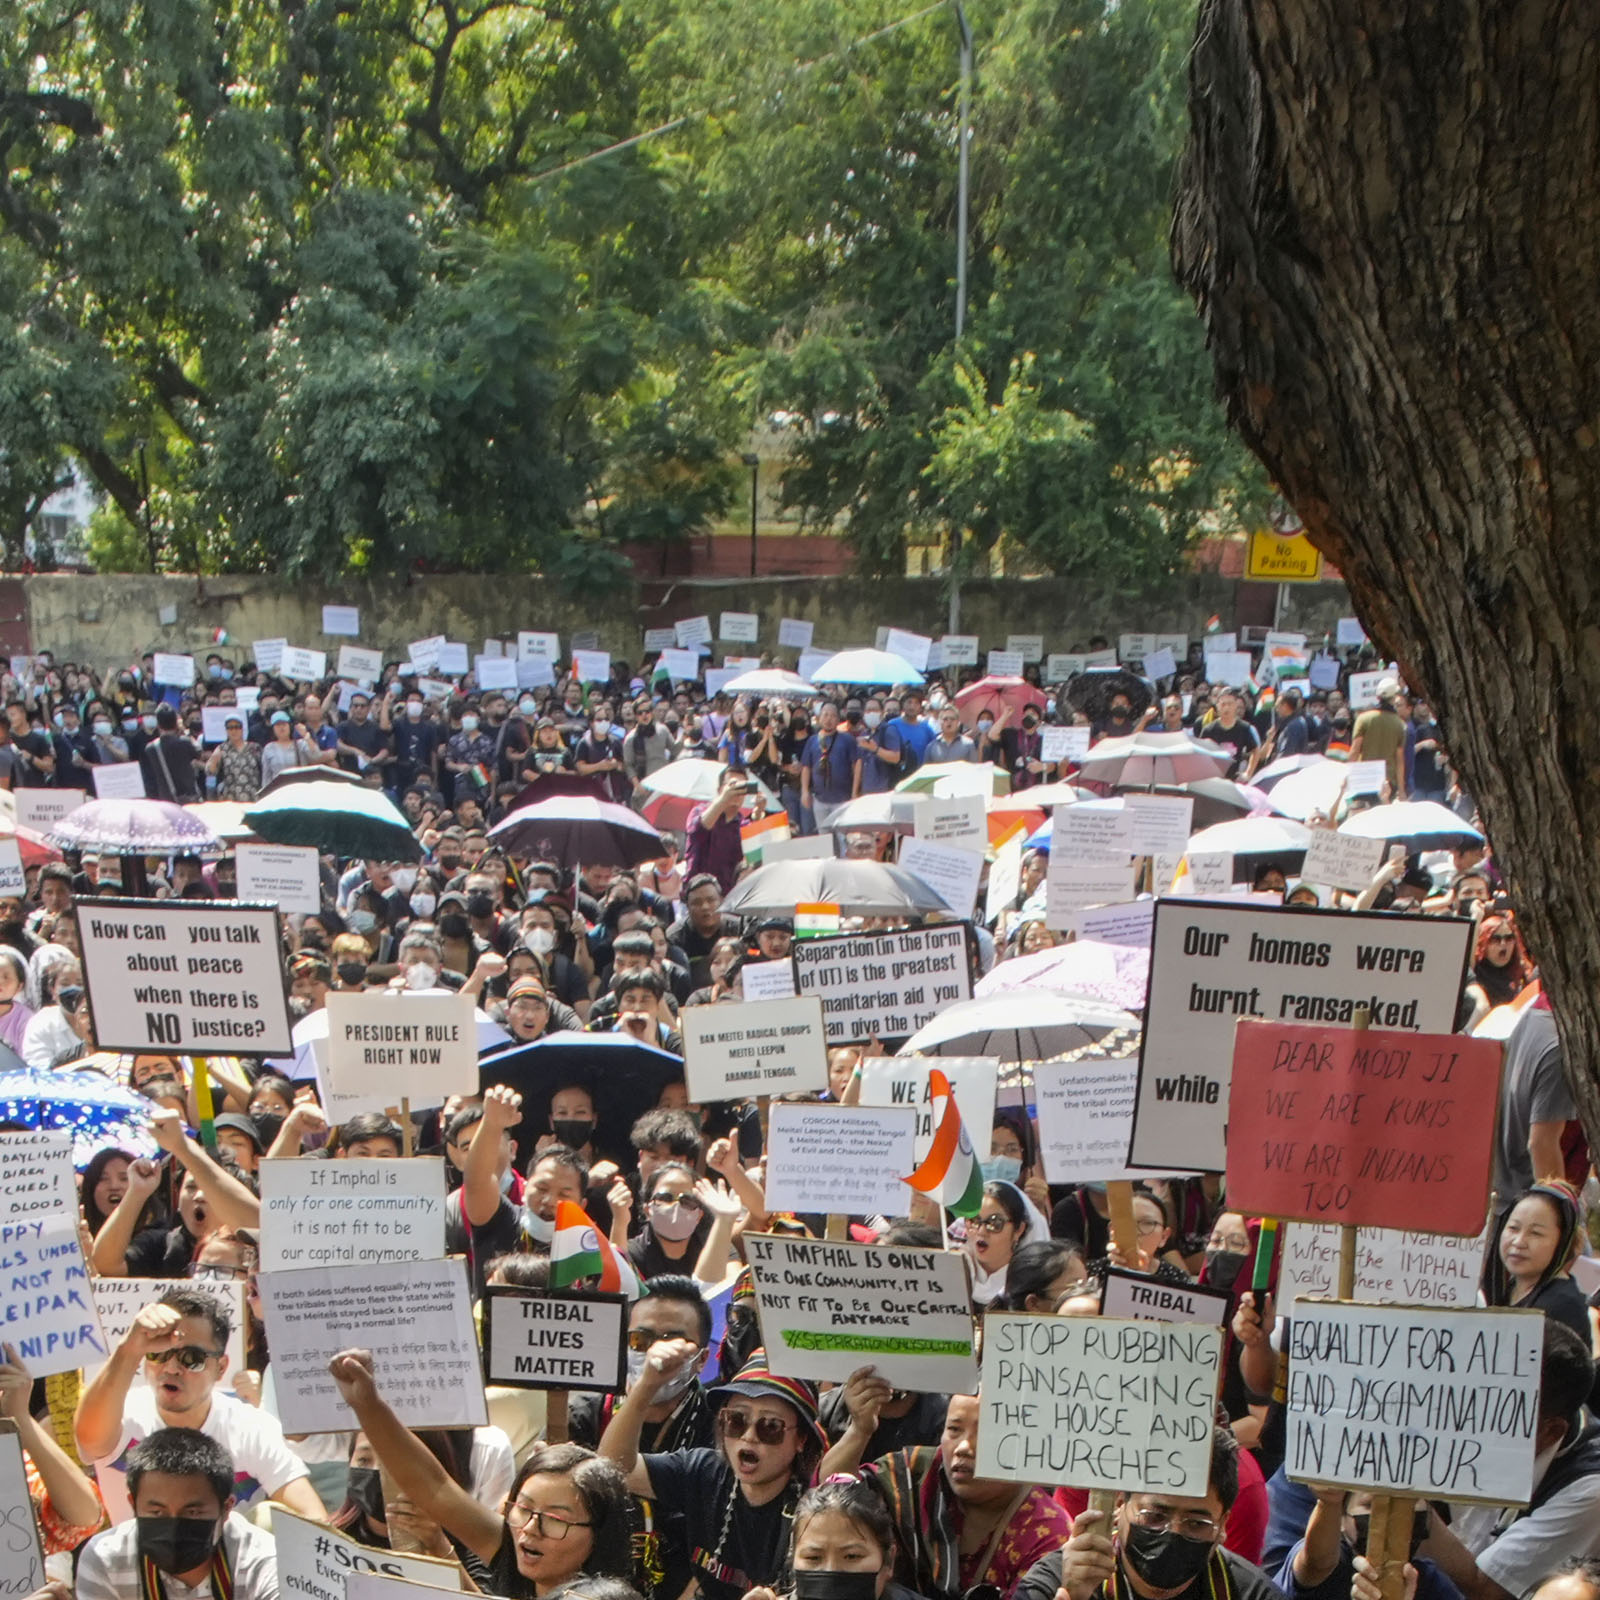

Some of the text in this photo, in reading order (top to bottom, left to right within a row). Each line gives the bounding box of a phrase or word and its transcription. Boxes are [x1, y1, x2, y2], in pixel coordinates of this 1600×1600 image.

[1276, 544, 1291, 556] No
[1261, 556, 1308, 573] Parking
[91, 920, 261, 944] How can you talk
[126, 953, 243, 975] about peace
[134, 986, 259, 1009] when there is
[146, 1012, 265, 1044] NO justice?
[345, 1024, 459, 1041] PRESIDENT RULE
[364, 1048, 442, 1065] RIGHT NOW
[311, 1170, 396, 1185] If Imphal is
[270, 1196, 438, 1213] only for one community,
[292, 1220, 412, 1234] it is not fit to be
[282, 1248, 303, 1260] our
[308, 1246, 354, 1262] capital
[521, 1301, 594, 1324] TRIBAL
[527, 1328, 584, 1350] LIVES
[996, 1322, 1217, 1371] STOP RUBBING
[514, 1355, 594, 1378] MATTER
[998, 1361, 1214, 1416] RANSACKING
[991, 1402, 1208, 1442] THE HOUSE AND
[996, 1433, 1188, 1487] CHURCHES
